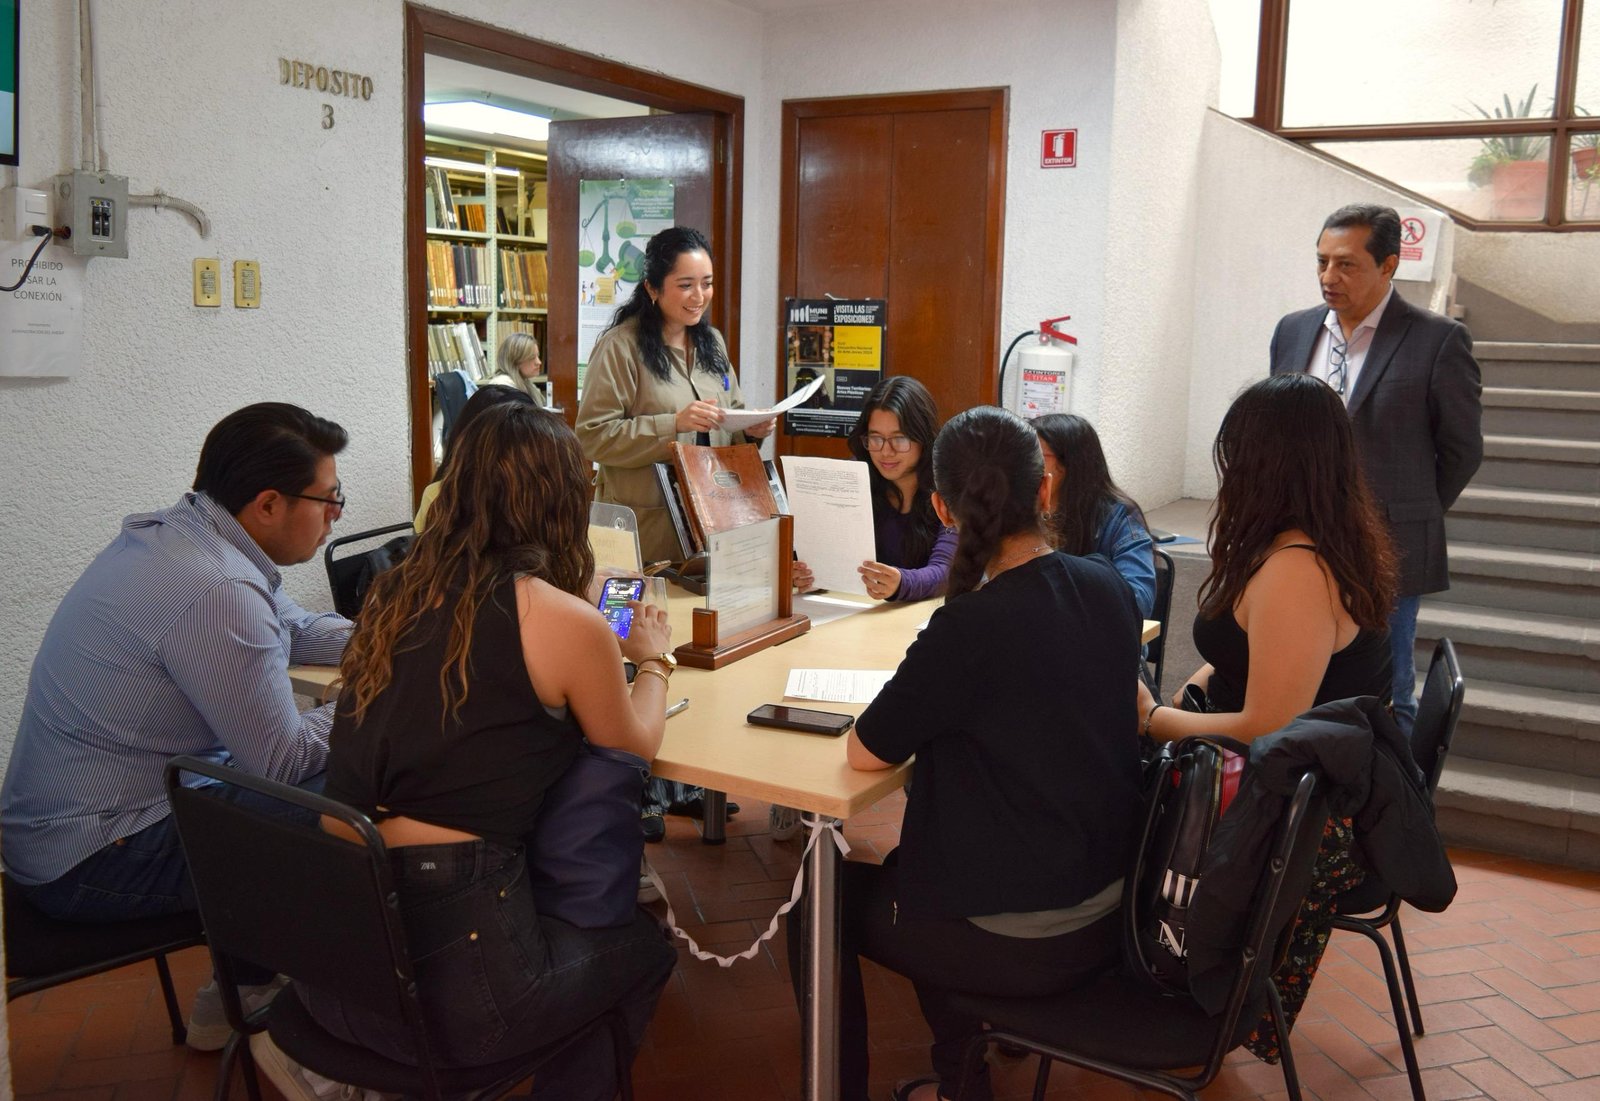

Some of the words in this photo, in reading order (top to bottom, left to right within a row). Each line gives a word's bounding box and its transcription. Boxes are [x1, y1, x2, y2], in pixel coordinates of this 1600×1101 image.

[278, 57, 374, 101] DEPOSITO
[321, 104, 336, 130] 3
[1044, 157, 1073, 165] EXTINTOR
[20, 274, 44, 285] SAR
[46, 276, 57, 286] LA
[13, 290, 63, 302] CONEXIÓN
[833, 304, 854, 315] ¡VISITA
[854, 305, 865, 313] LAS
[833, 314, 876, 324] EXPOSICIONES!
[1032, 375, 1054, 383] TITAN
